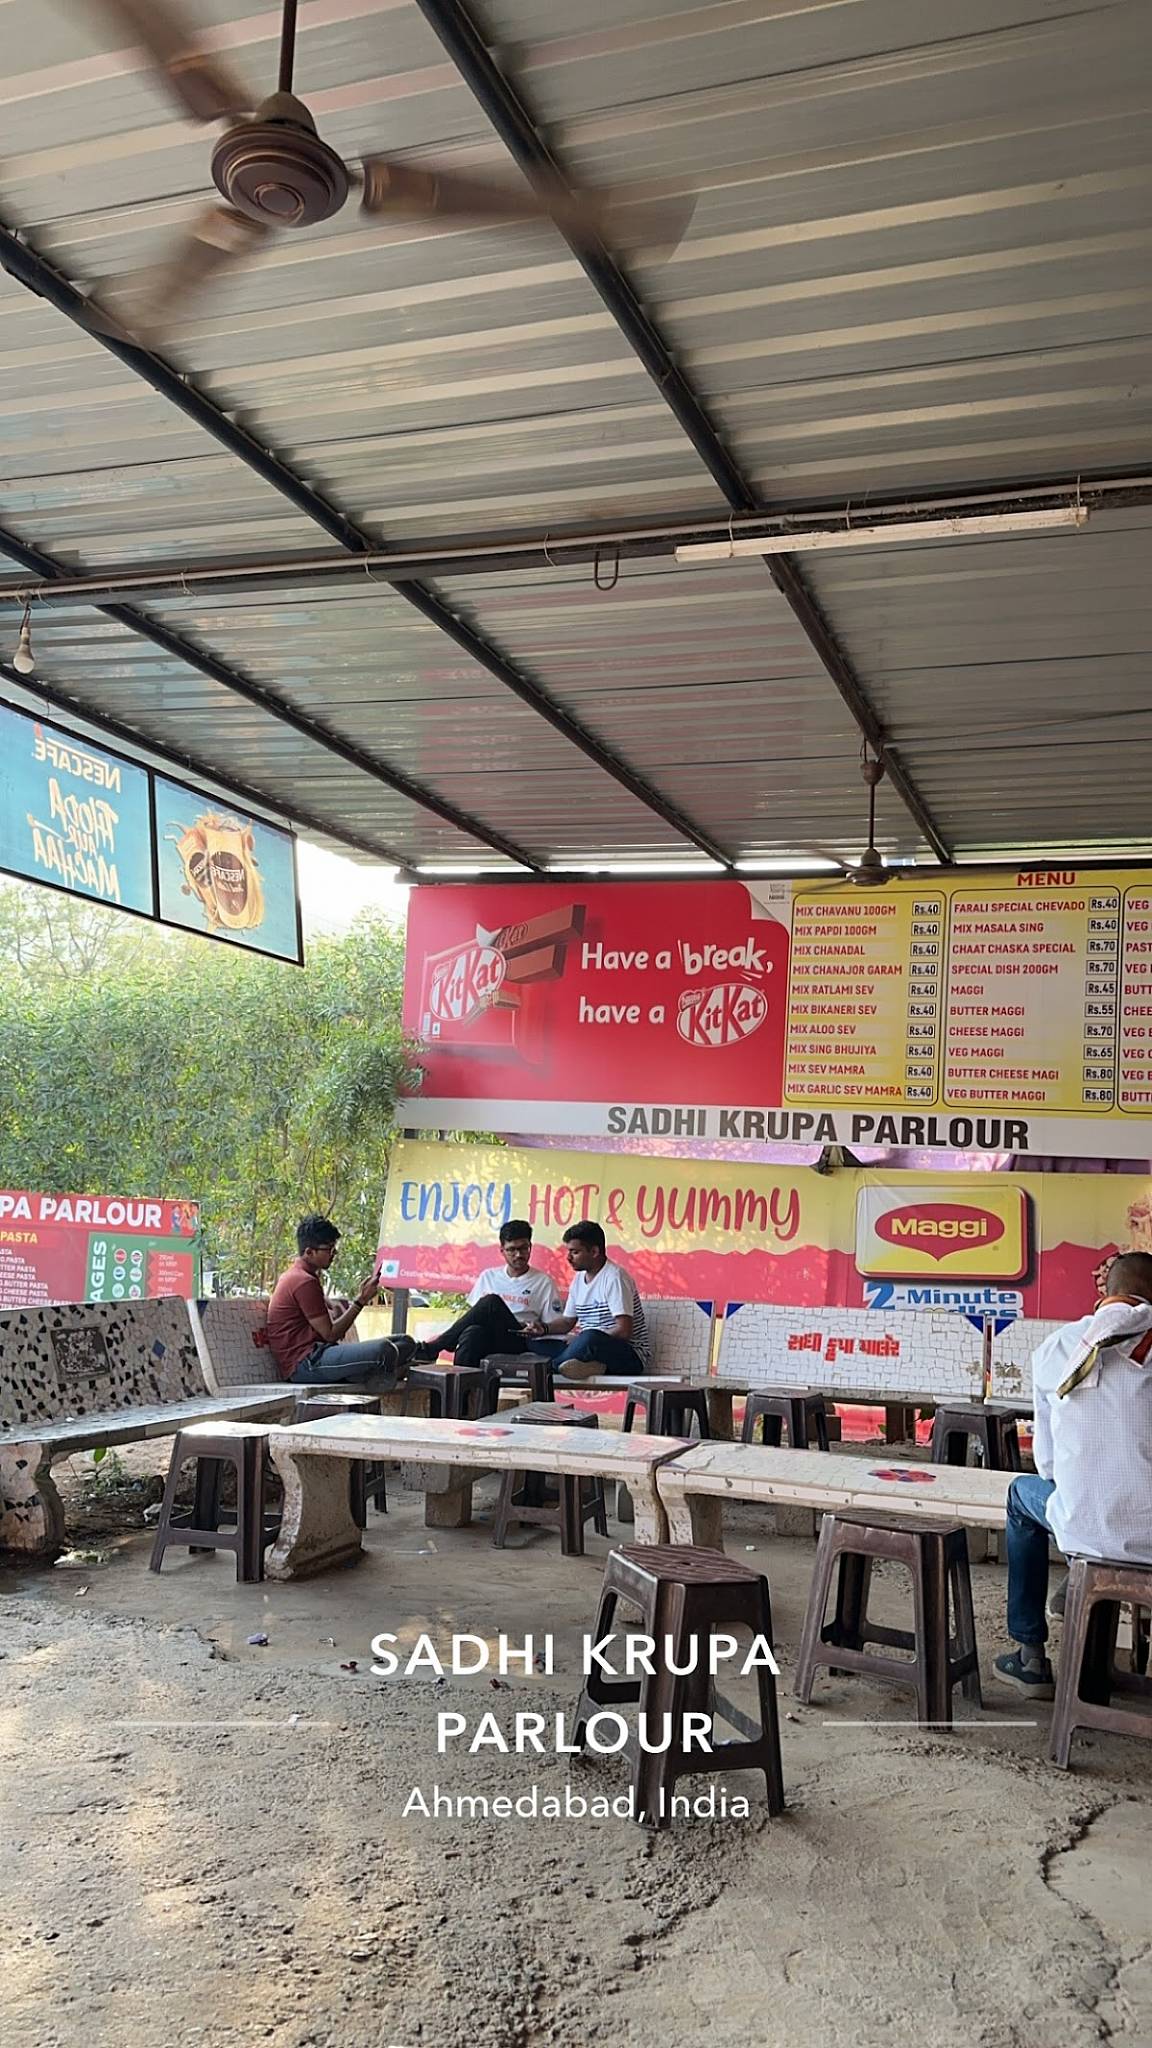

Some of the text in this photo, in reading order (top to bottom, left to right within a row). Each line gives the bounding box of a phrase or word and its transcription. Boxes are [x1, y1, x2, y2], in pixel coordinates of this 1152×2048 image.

[1017, 872, 1076, 886] MENU
[796, 904, 939, 917] MIX CHAVANU 100GM Rs.40
[954, 898, 1118, 912] FARALI SPECIAL CHEVADO Rs.40
[1127, 900, 1149, 910] VEG
[795, 924, 937, 936] MIX PAPDI 100GM Rs.40
[953, 920, 1117, 933] MIX MASALA SING Rs.40
[1127, 922, 1149, 931] VEG
[794, 945, 937, 956] MIX CHANADAL Rs.40
[952, 941, 1115, 953] CHAAT CHASKA SPECIAL Rs.70
[581, 937, 774, 975] Have a break,
[793, 965, 936, 975] MIX CHANAJOR GARAM Rs.40
[952, 962, 1115, 974] SPECIAL DISH 200GM Rs.70
[1125, 963, 1147, 973] VEG
[436, 949, 500, 1019] KitKat
[792, 985, 935, 995] MIX RATLAMI SEV Rs.40
[951, 983, 1115, 995] MAGGI Rs.45
[579, 996, 641, 1024] have
[649, 1005, 665, 1024] a
[688, 985, 762, 1045] KitKat
[791, 1005, 934, 1015] MIX BIKANERI SEV Rs.40
[950, 1004, 1114, 1016] BUTTER MAGGI Rs.55
[790, 1024, 933, 1036] MIX ALOO SEV Rs.40
[949, 1025, 1113, 1037] CHEESE MAGGI Rs.70
[1123, 1028, 1145, 1037] VEG
[789, 1044, 933, 1056] MIX SING BHUJIYA Rs.40
[948, 1046, 1113, 1057] VEG MAGGI Rs.65
[1123, 1049, 1145, 1059] VEG
[788, 1064, 932, 1077] MIX SEV MAMRA Rs.40
[947, 1068, 1113, 1080] BUTTER CHEESE MAGI Rs.80
[1122, 1071, 1144, 1080] VEG
[787, 1084, 931, 1097] MIX GARLIC SEV MAMRA Rs.40
[947, 1089, 1112, 1101] VEG BUTTER MAGGI Rs.80
[607, 1107, 1029, 1150] SADHI KRUPA PARLOUR
[39, 1198, 162, 1228] PARLOUR
[529, 1183, 599, 1225] HOT
[605, 1189, 625, 1231] &
[892, 1218, 987, 1238] Maggi
[0, 1231, 38, 1244] PASTA
[864, 1283, 1017, 1310] 2-Minute
